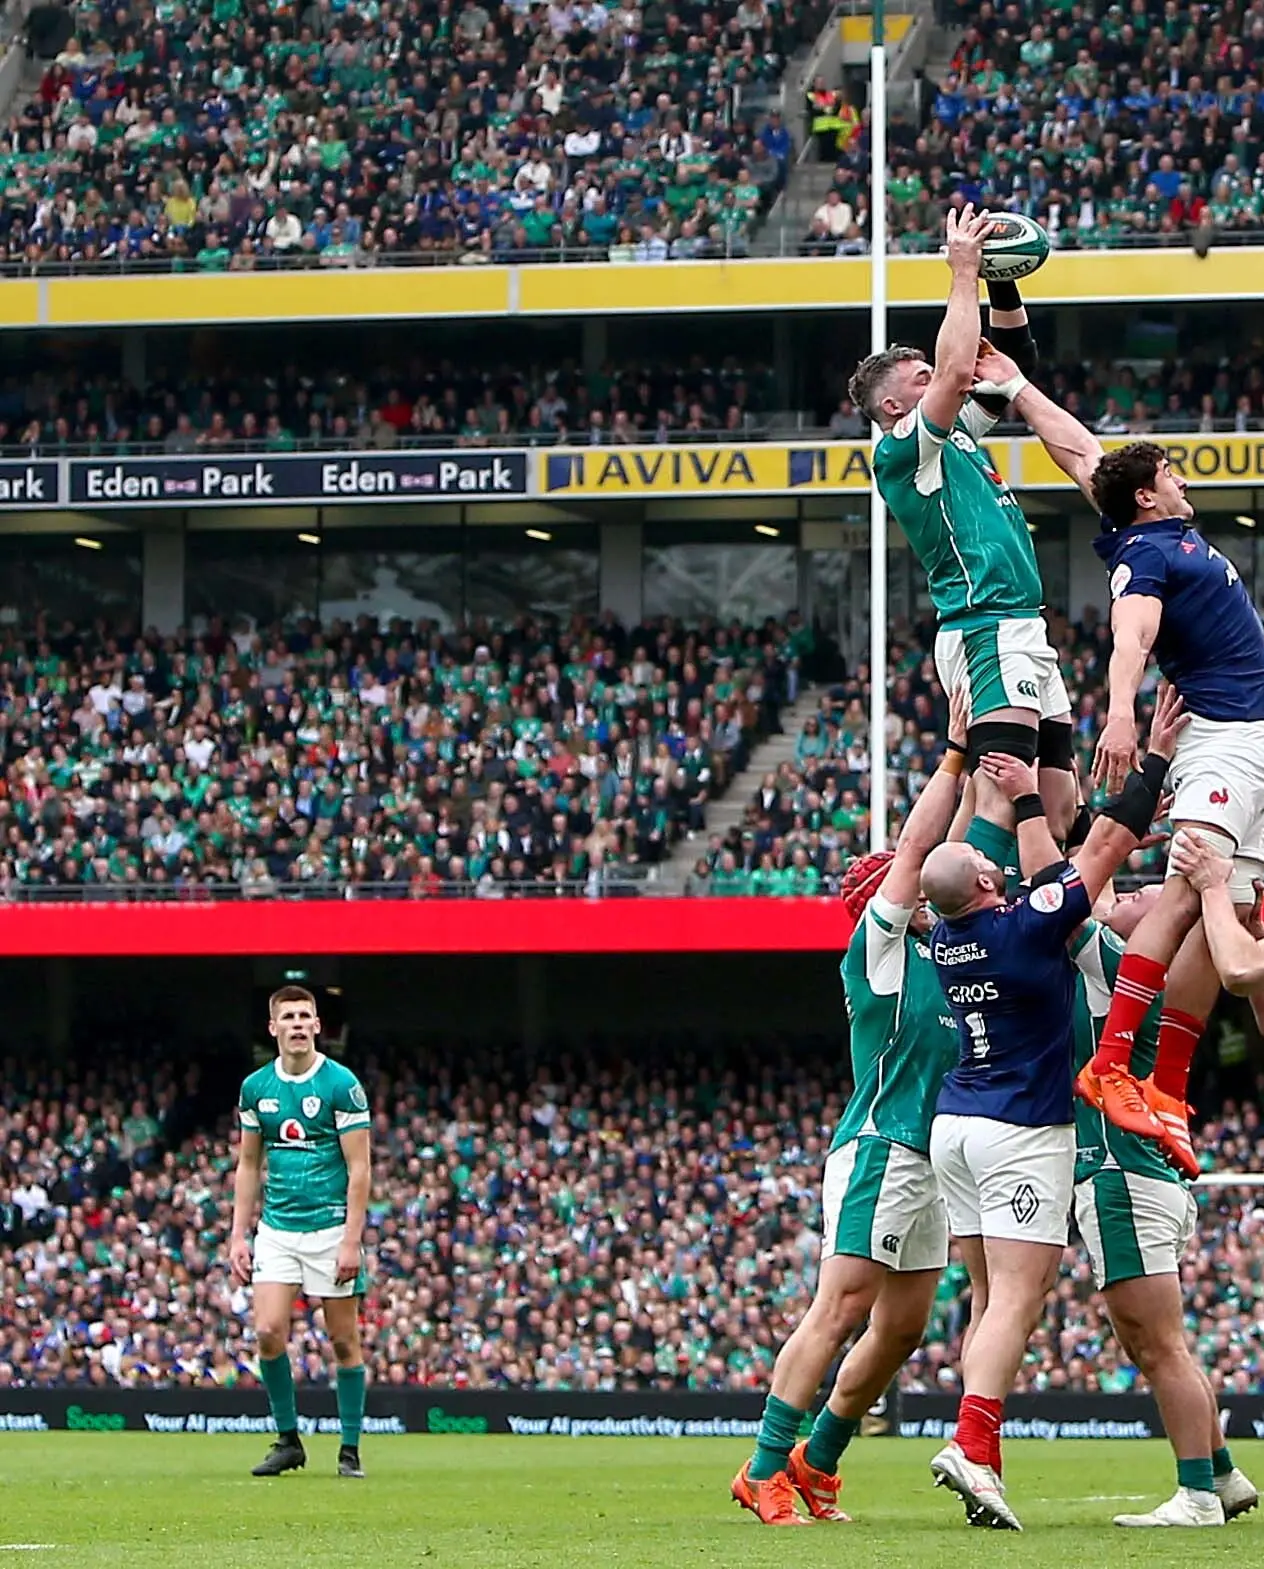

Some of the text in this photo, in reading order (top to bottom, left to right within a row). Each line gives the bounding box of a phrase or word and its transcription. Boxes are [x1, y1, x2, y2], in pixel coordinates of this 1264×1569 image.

[984, 259, 1032, 279] BERT
[0, 466, 44, 499] ark
[87, 462, 273, 498] Eden Park
[322, 457, 512, 493] Eden Park
[597, 451, 755, 486] AVIVA
[965, 1012, 991, 1059] 1
[144, 1413, 184, 1432] Your
[186, 1414, 206, 1432] AI
[506, 1415, 548, 1434] Your
[550, 1416, 569, 1434] AI
[571, 1416, 683, 1438] productivity
